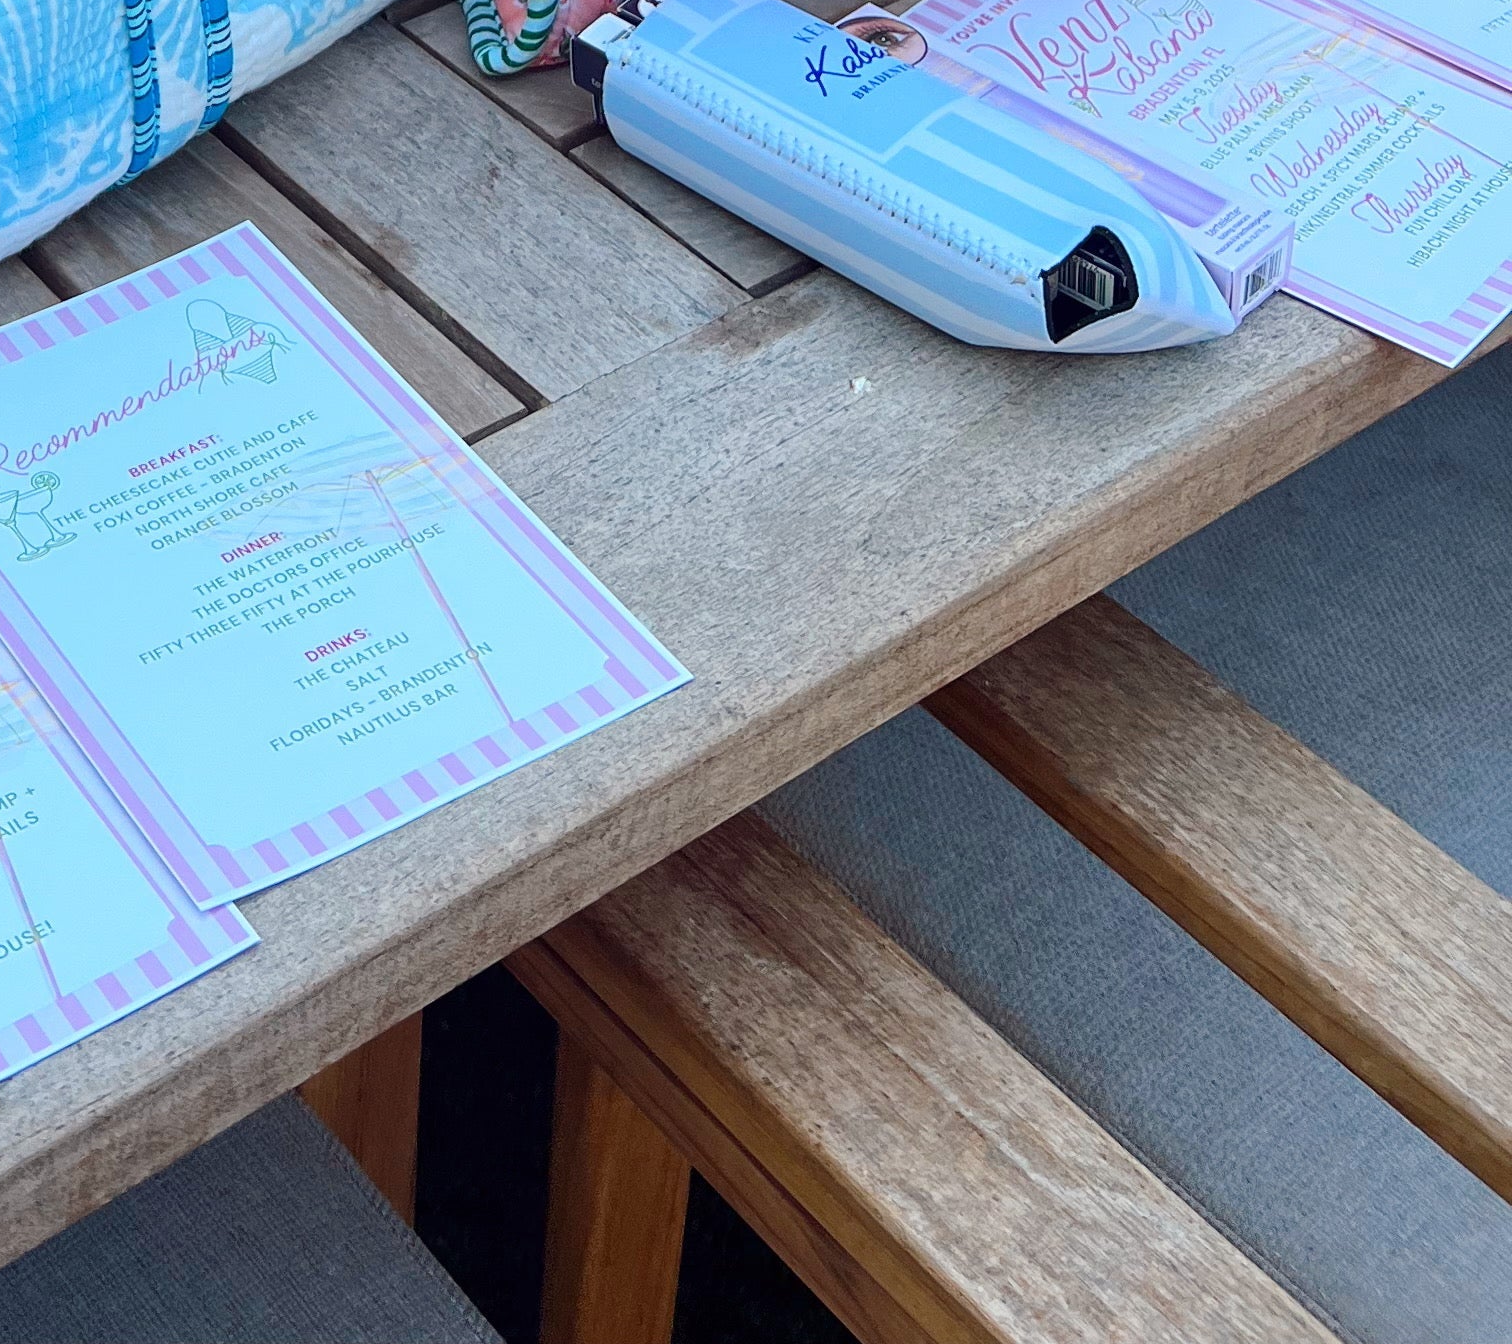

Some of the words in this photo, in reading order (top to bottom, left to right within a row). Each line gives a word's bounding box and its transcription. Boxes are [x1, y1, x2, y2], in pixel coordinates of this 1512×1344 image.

[792, 21, 836, 44] KEN
[53, 508, 87, 527] THE
[88, 465, 192, 514] CHEESECAKE
[193, 445, 240, 471] CUTIE
[243, 430, 275, 451] AND
[277, 410, 319, 434] CAFE
[93, 510, 133, 533] FOXI
[135, 484, 198, 516] COFFEE
[209, 436, 306, 484] BRADENTON
[128, 434, 223, 478] BREAKFAST:
[135, 508, 189, 536] NORTH
[193, 482, 247, 512] SHORE
[249, 463, 292, 488] CAFE
[151, 515, 220, 550] ORANGE
[220, 481, 299, 521] BLOSSOM
[191, 598, 228, 619] THE
[227, 563, 308, 605] DOCTORS
[310, 536, 368, 568] OFFICE
[192, 576, 228, 596] THE
[227, 527, 337, 581] WATERFRONT
[220, 531, 283, 564] DINNER:
[138, 638, 184, 665] FIFTY
[185, 614, 242, 644] THREE
[241, 594, 285, 621] FIFTY
[290, 583, 310, 601] AT
[311, 568, 347, 589] THE
[346, 523, 445, 574] POURHOUSE
[261, 613, 297, 634] THE
[296, 586, 356, 619] PORCH
[293, 668, 330, 690] THE
[330, 631, 409, 674] CHATEAU
[304, 628, 372, 662] DRINKS:
[269, 701, 365, 752] FLORIDAYS
[378, 641, 493, 701] BRANDENTON
[345, 665, 388, 692] SALT
[337, 700, 422, 746] NAUTILUS
[421, 683, 459, 706] BAR
